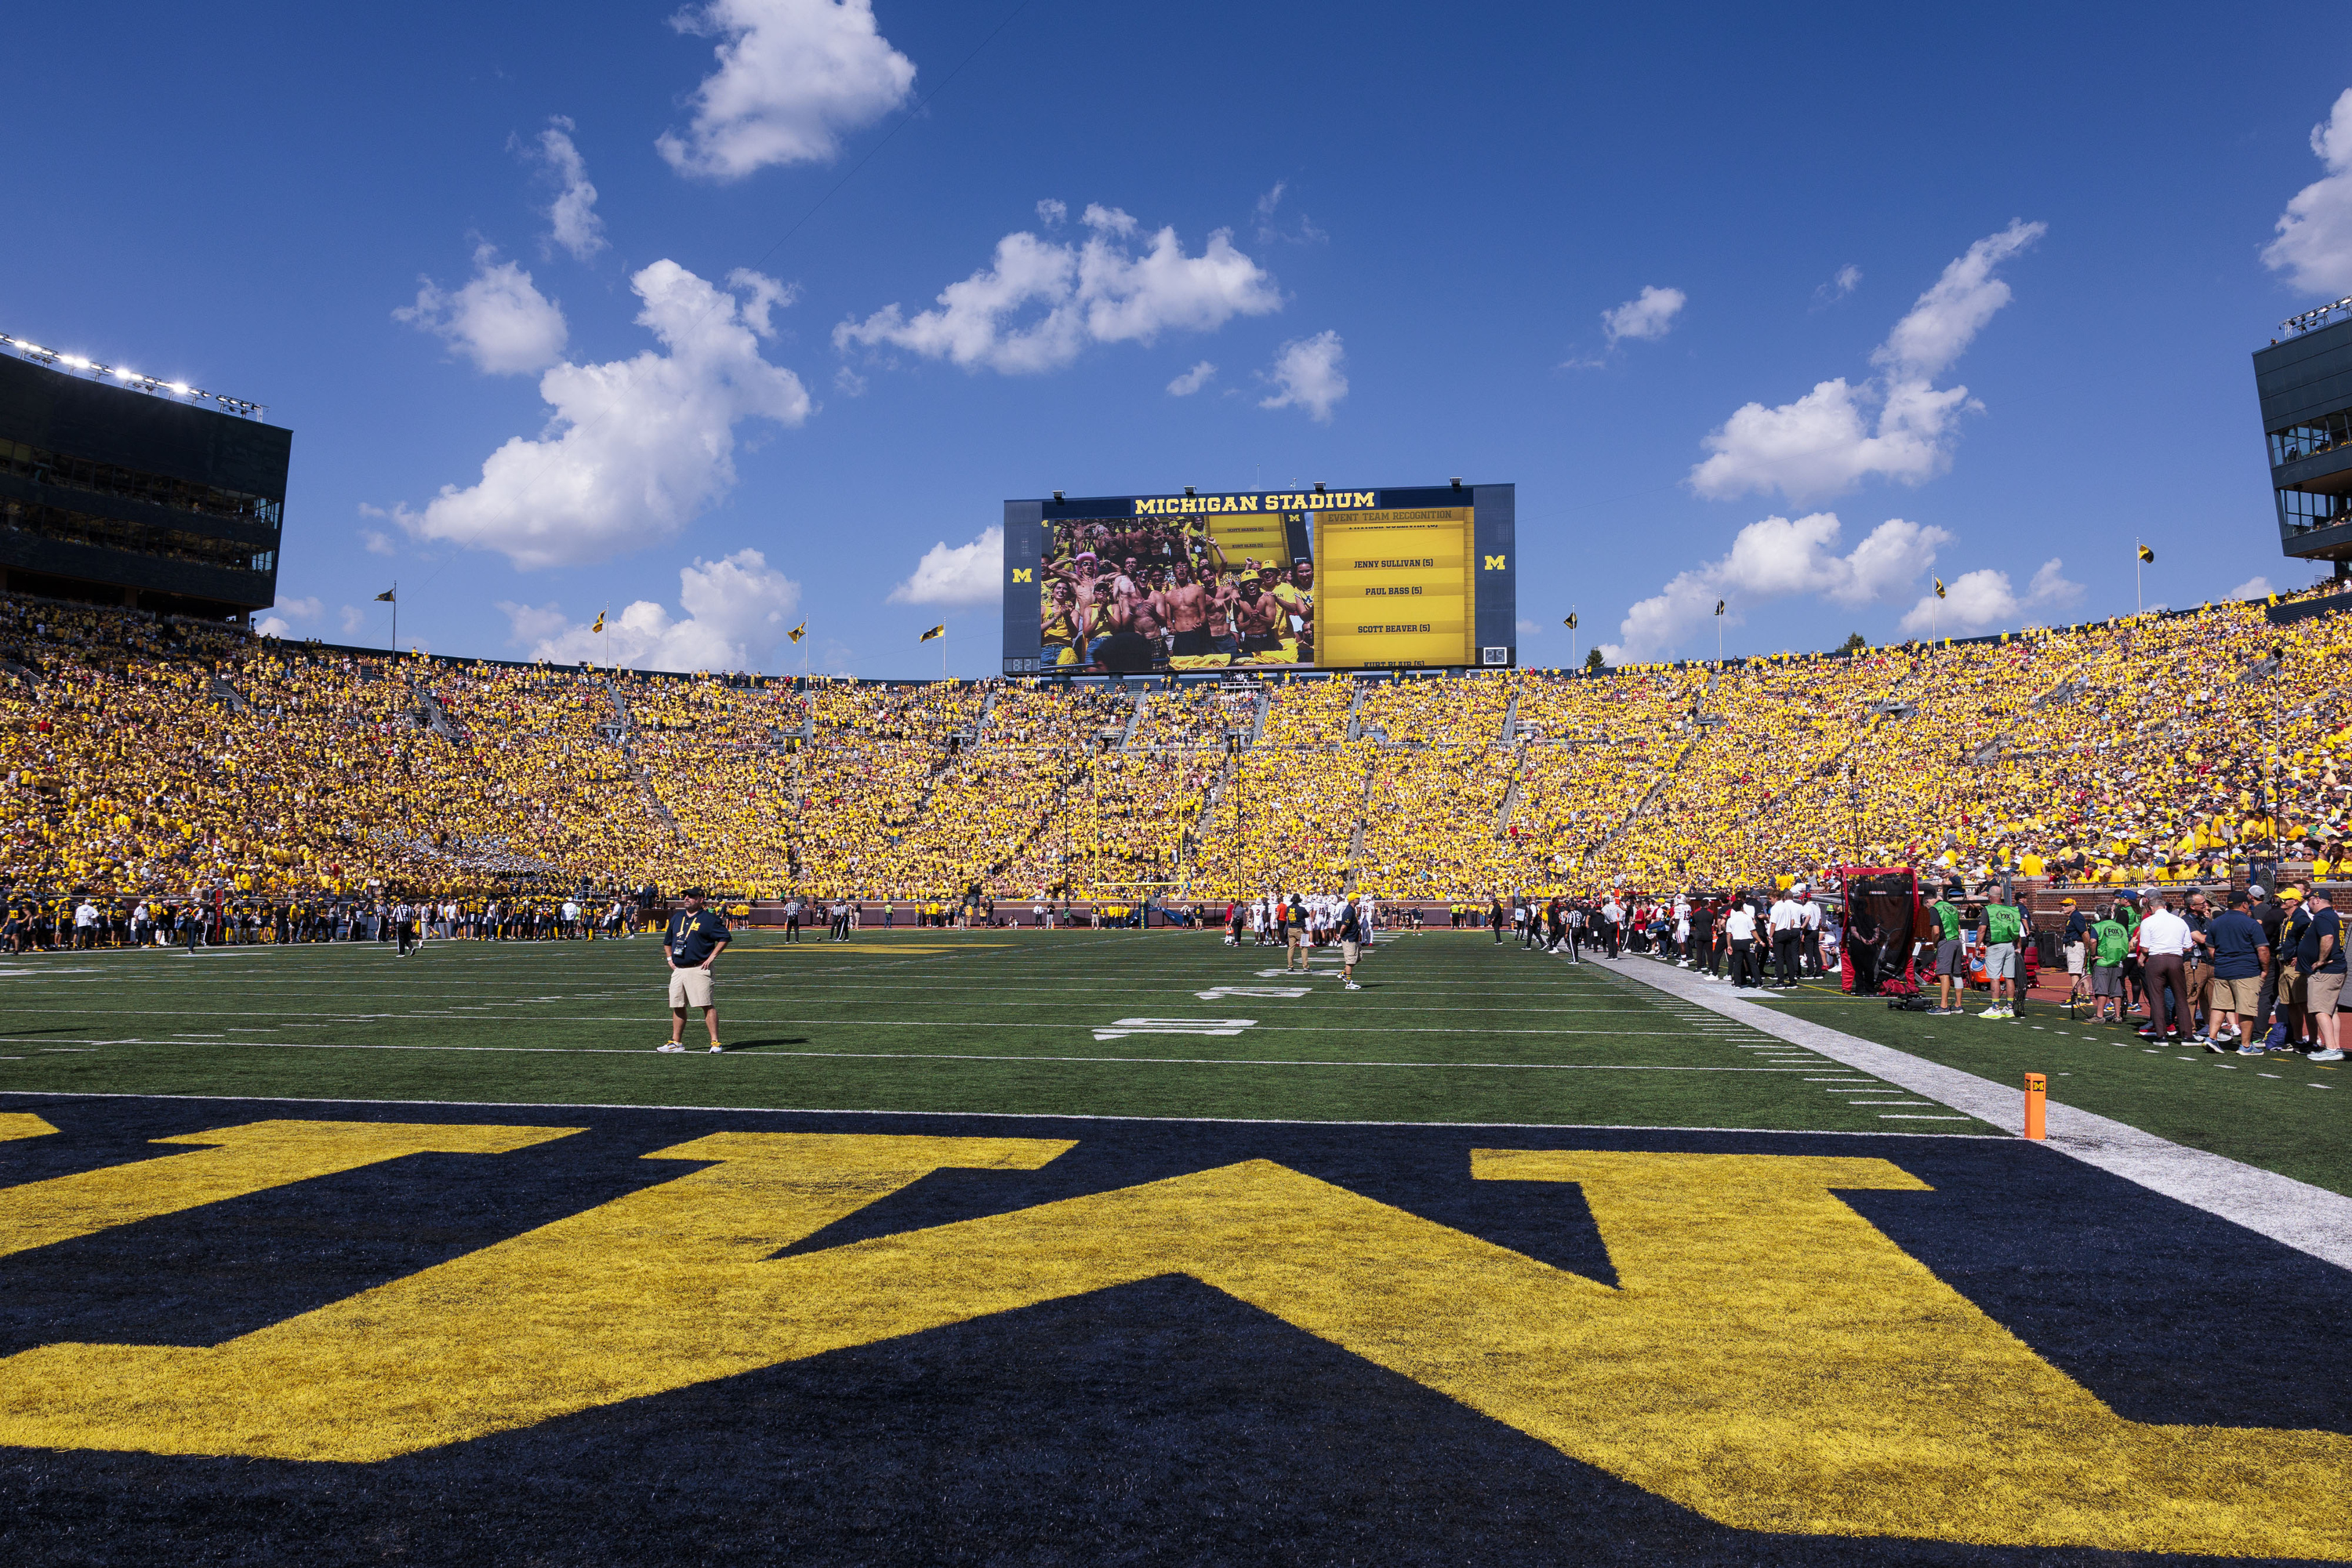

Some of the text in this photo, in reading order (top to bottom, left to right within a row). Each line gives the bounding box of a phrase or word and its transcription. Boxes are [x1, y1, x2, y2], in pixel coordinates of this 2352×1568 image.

[1135, 492, 1374, 514] MICHIGAN STADIUM
[1328, 510, 1452, 522] EVENT TEAM RECOGNITION
[1381, 559, 1421, 568] SULLIVAN
[1423, 558, 1433, 567] (5)
[1484, 555, 1505, 570] M
[1012, 568, 1032, 583] M
[1388, 586, 1410, 595] BASS
[1411, 586, 1422, 595] (5)
[1385, 624, 1417, 633] BEAVER
[1419, 623, 1430, 632] (5)
[1486, 649, 1504, 662] 25
